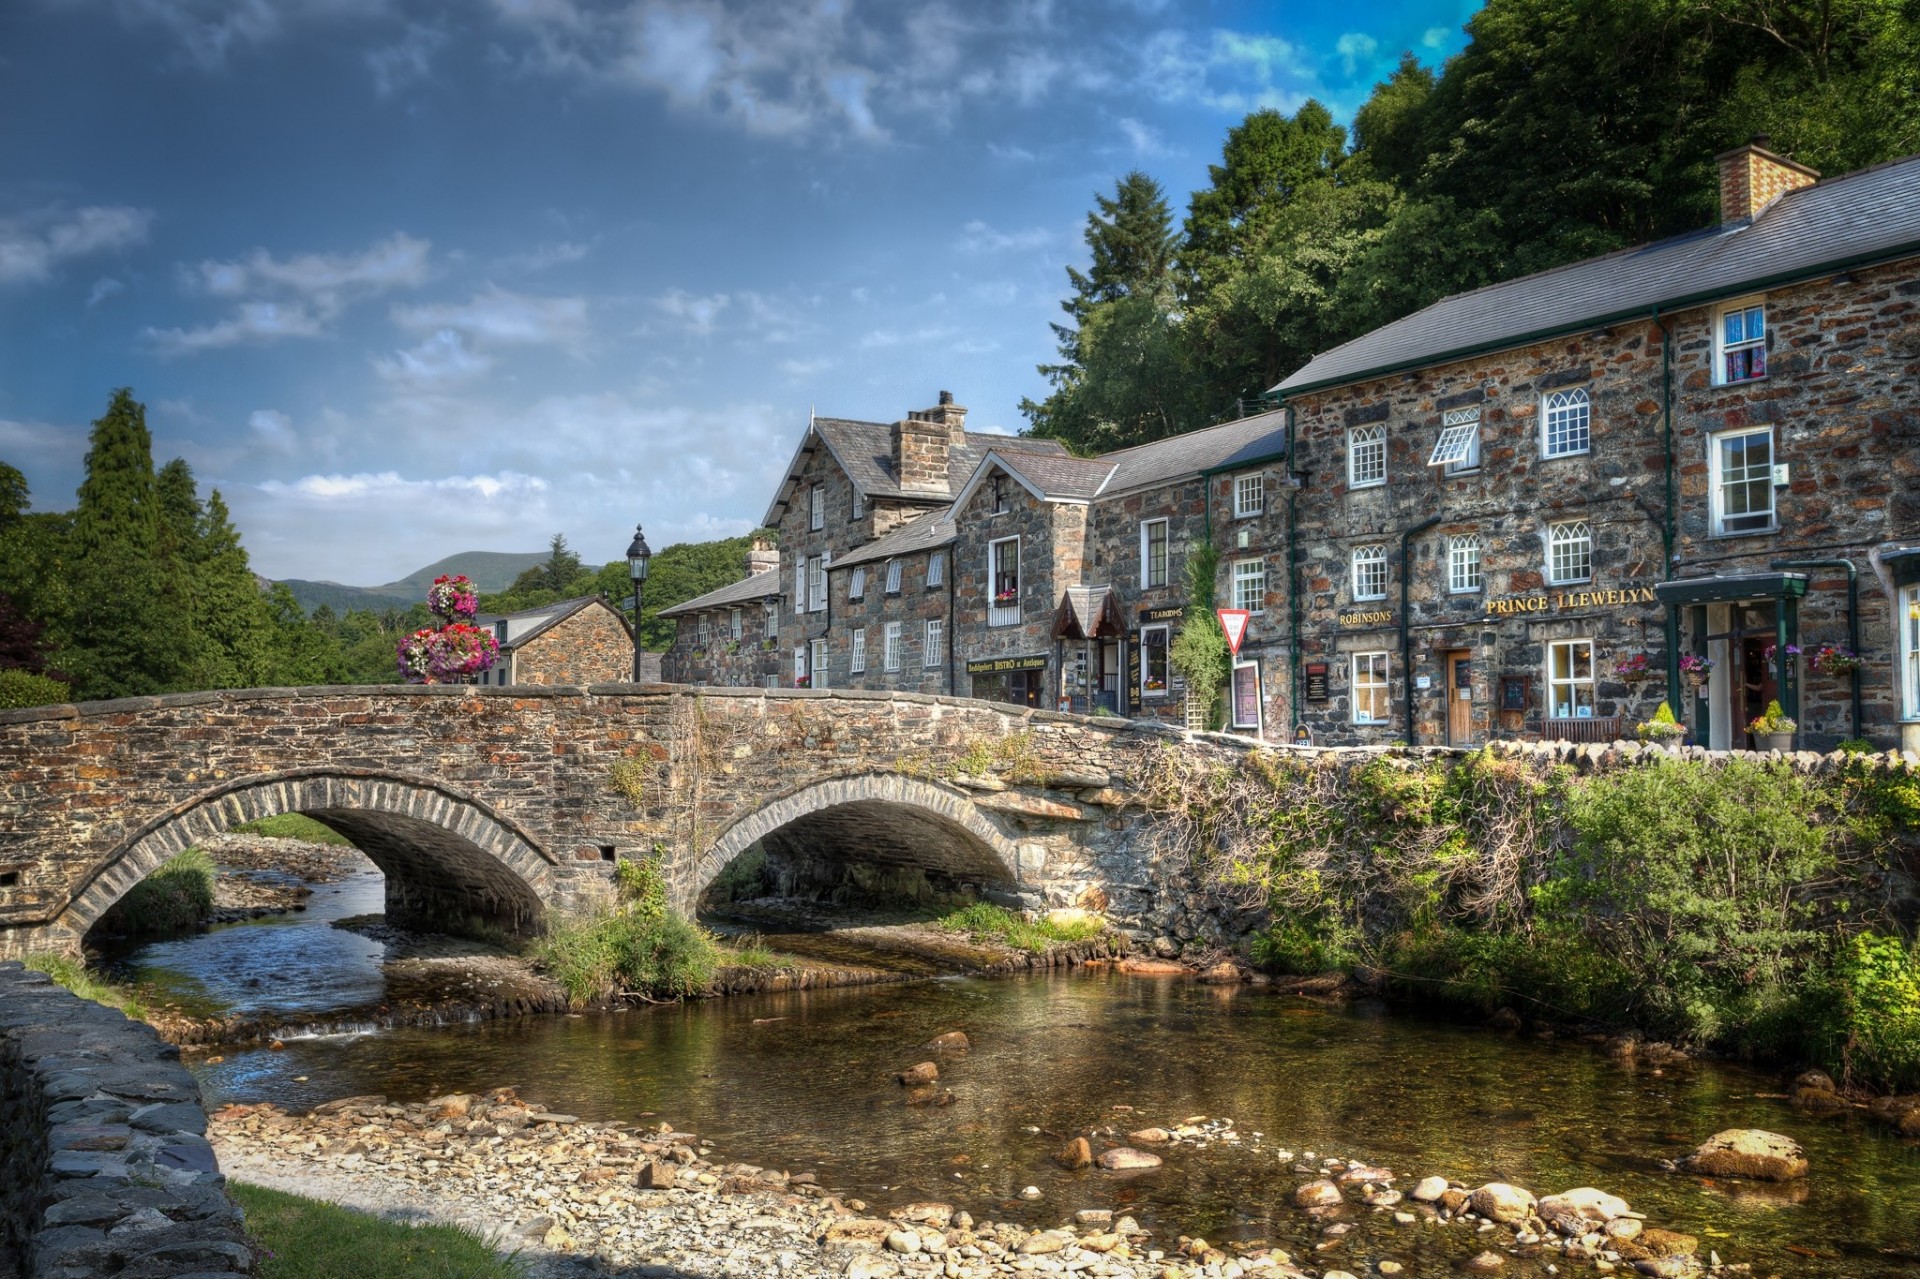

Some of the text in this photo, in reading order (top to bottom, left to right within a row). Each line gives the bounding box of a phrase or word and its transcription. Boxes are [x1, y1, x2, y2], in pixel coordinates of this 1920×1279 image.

[1486, 587, 1655, 614] PRINCE LLEWELYN
[1150, 607, 1183, 620] TEAROOMS
[1340, 610, 1391, 625] ROBINSONS
[994, 659, 1015, 670] BISTRO
[1023, 658, 1045, 668] Antiques
